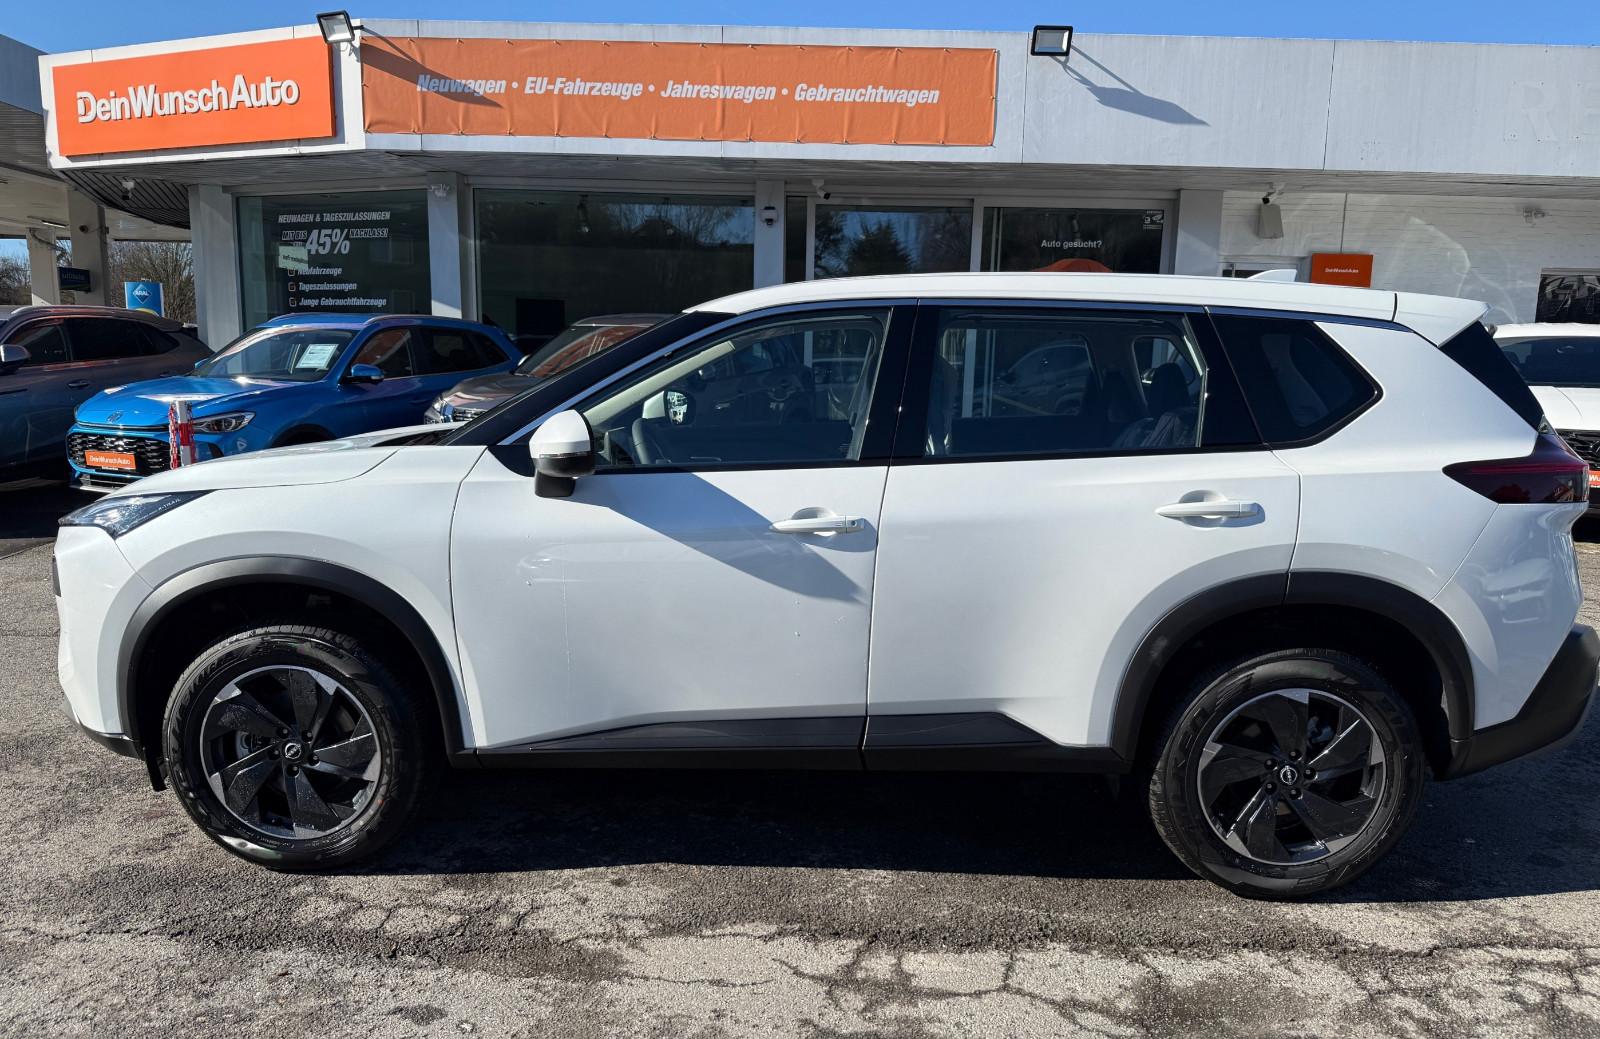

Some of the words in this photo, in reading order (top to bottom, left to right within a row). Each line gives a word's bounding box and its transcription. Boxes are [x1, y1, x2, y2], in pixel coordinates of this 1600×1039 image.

[416, 74, 507, 96] Neuwagen
[524, 77, 644, 100] EU-Fahrzeuge
[660, 80, 777, 103] Jahreswagen
[794, 83, 940, 107] Gebrauchtwagen
[76, 74, 300, 123] DeinWunschAuto
[278, 214, 314, 223] NEUWAGEN
[315, 213, 321, 222] &
[323, 211, 390, 221] TAGESZULASSUNGEN
[305, 229, 350, 255] 45%
[1040, 239, 1061, 248] Auto
[1062, 240, 1103, 250] gesucht?
[299, 283, 357, 292] Tageszulassungen
[299, 297, 319, 307] Junge
[320, 297, 387, 307] Gebrauchtfahrzeuge
